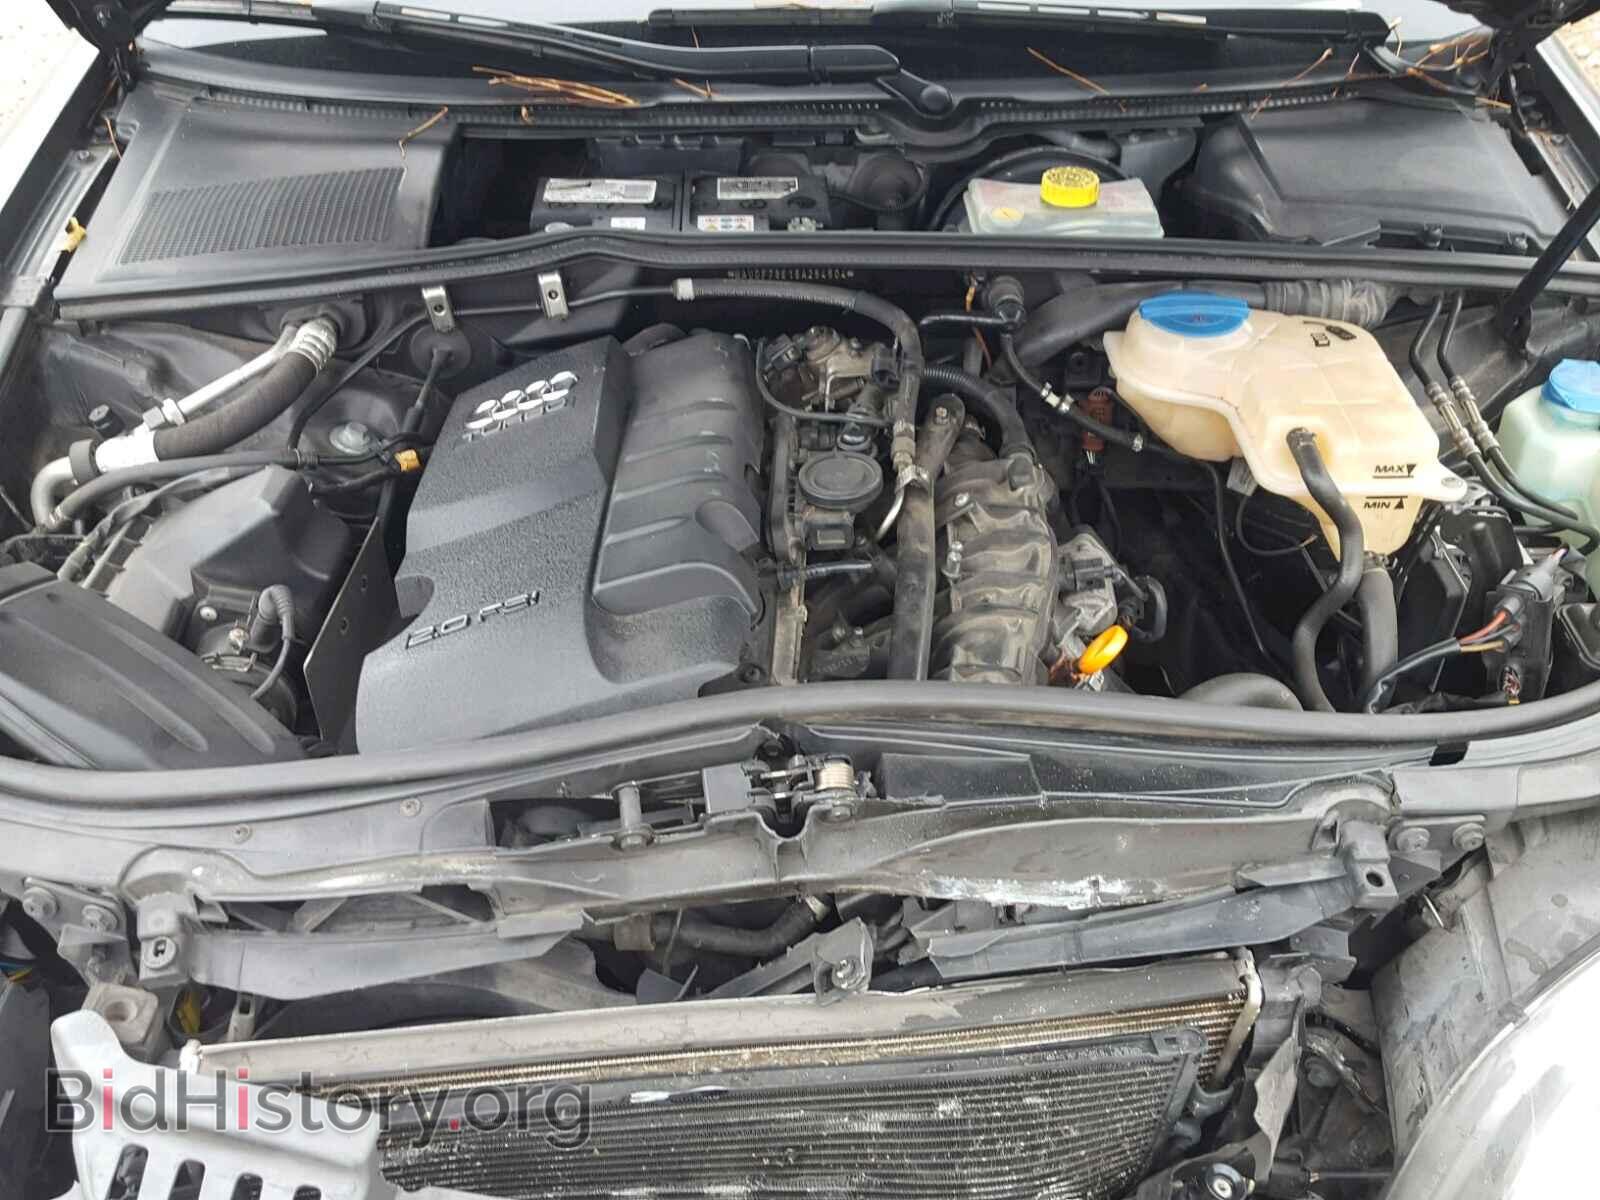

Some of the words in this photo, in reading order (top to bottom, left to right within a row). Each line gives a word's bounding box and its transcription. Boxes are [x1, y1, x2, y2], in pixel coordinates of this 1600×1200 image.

[1374, 464, 1405, 473] MAX
[1363, 501, 1391, 509] MIN
[405, 613, 472, 650] 2.0
